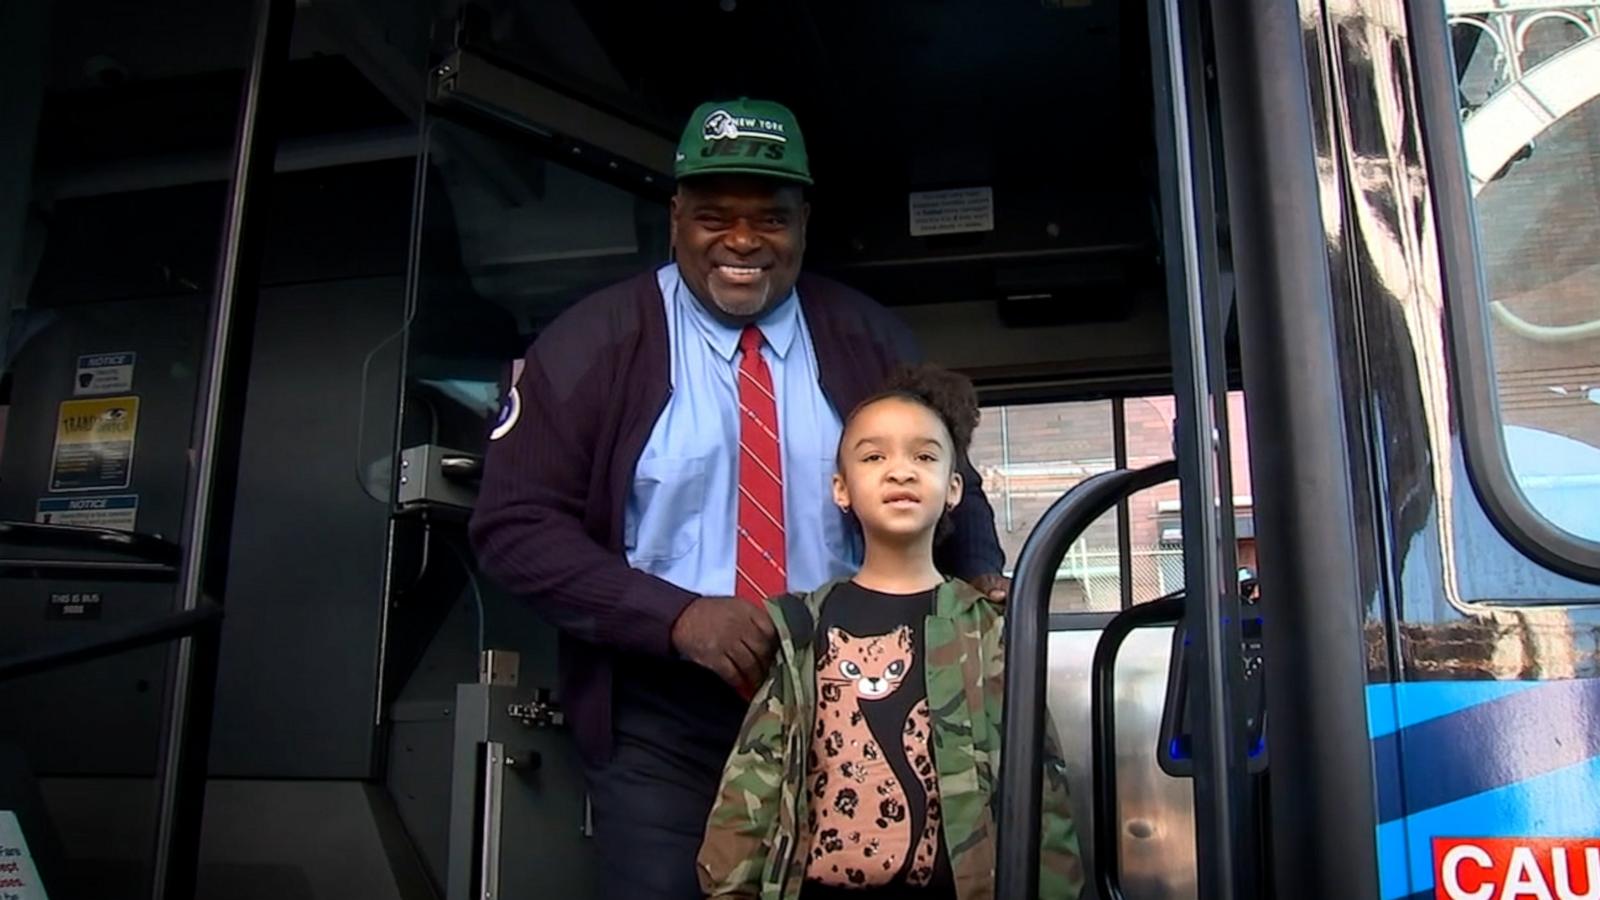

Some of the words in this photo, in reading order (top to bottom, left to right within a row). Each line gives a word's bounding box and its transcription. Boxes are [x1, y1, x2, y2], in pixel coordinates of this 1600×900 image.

[734, 117, 756, 128] NEW
[759, 119, 784, 132] YORK
[701, 141, 785, 159] JETS
[87, 355, 127, 366] NOTICE
[68, 498, 108, 509] NOTICE
[51, 594, 70, 603] THIS
[71, 593, 81, 603] IS
[82, 593, 100, 603] BUS
[1441, 844, 1600, 900] CAU
